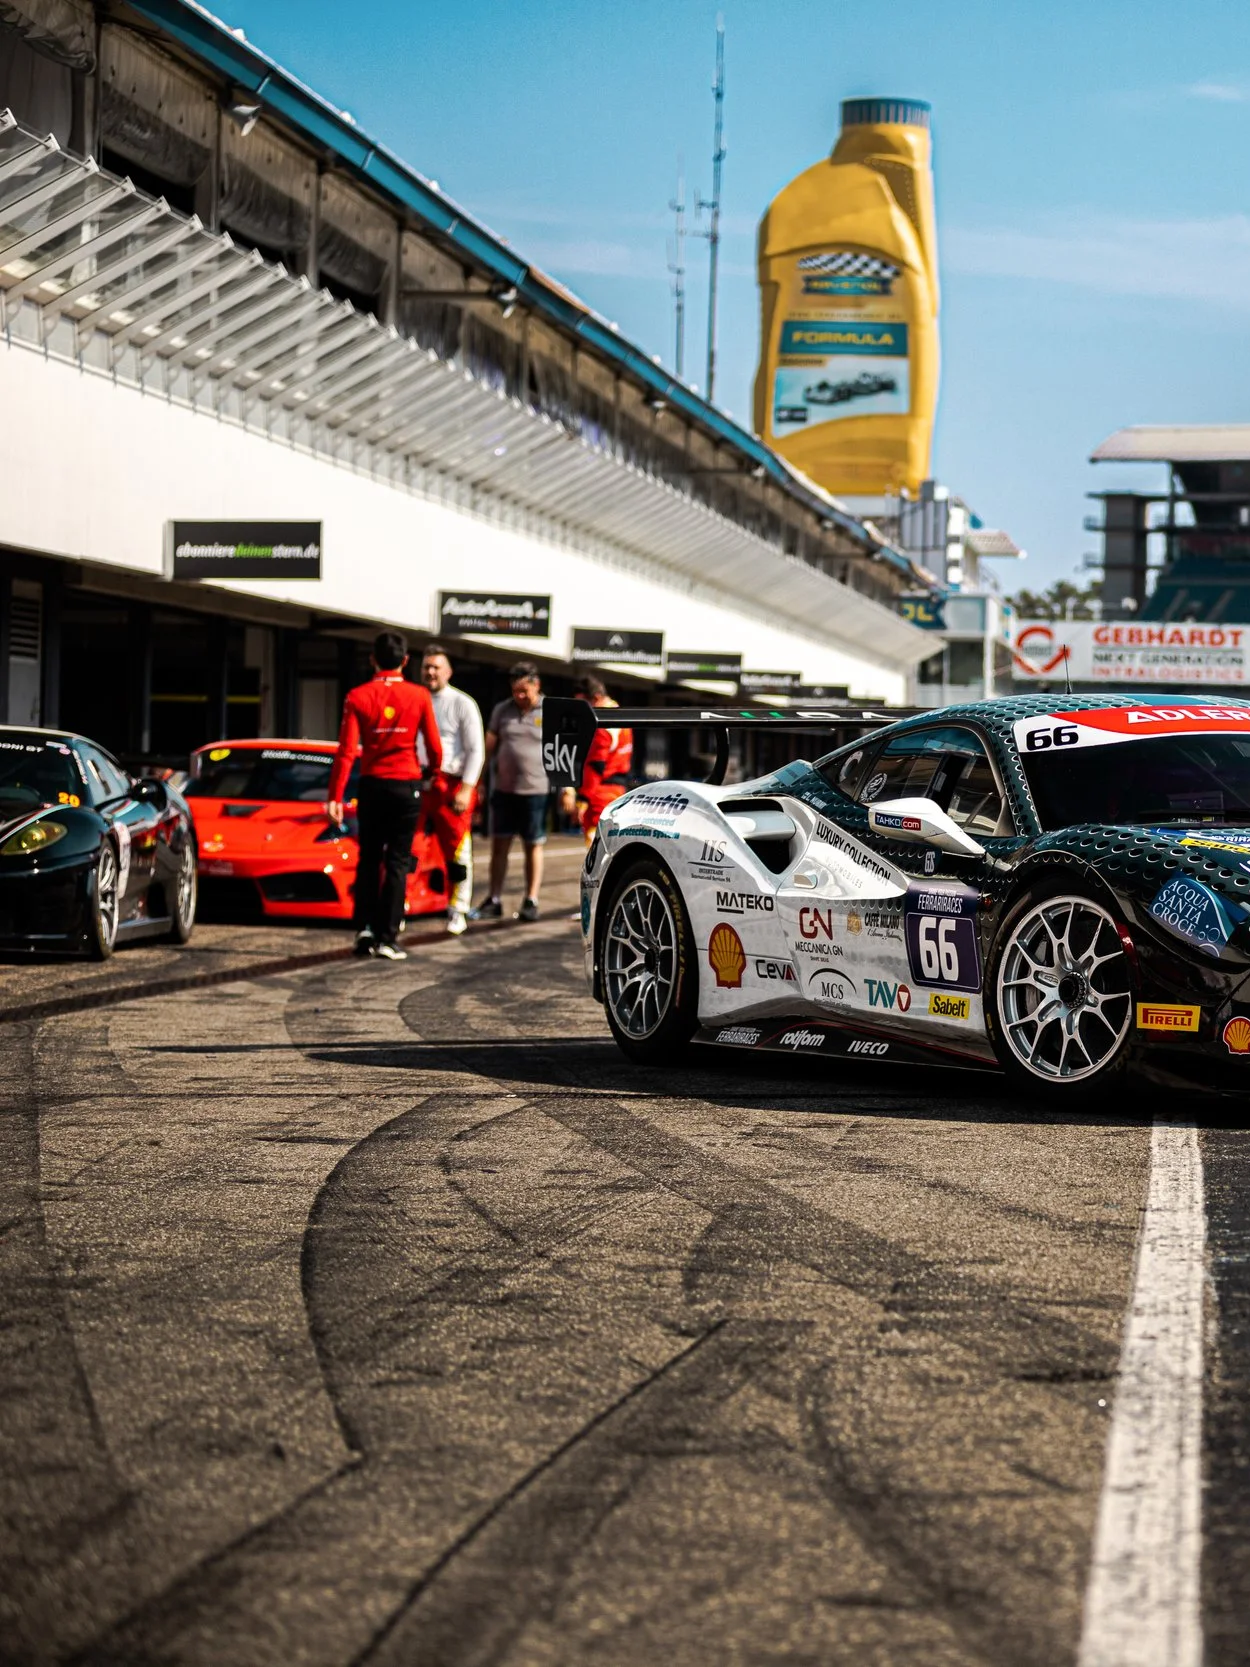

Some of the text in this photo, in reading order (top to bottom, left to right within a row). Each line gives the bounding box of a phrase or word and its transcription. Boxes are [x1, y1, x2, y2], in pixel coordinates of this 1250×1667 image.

[792, 331, 894, 346] FORMULA
[1093, 626, 1244, 647] GEBHARDT
[1093, 652, 1244, 666] NEXT GENERATION
[1092, 666, 1244, 681] INTRALOGISTICS
[1026, 725, 1079, 751] 66
[543, 733, 578, 782] sky
[57, 792, 81, 808] 20
[876, 814, 900, 828] TAHKO
[816, 821, 892, 886] LUXURY COLLECTION
[716, 891, 774, 911] MATEKO
[1168, 880, 1211, 912] ACQUA
[1159, 889, 1202, 925] SANTA
[799, 907, 834, 941] GN
[1152, 902, 1198, 937] CROCE
[794, 940, 844, 957] MECCANICA GN
[918, 916, 959, 982] 66
[820, 981, 844, 1000] MCS
[932, 995, 967, 1018] Sabelt
[1142, 1007, 1194, 1027] PIRELLI
[780, 1029, 826, 1050] rotiform
[848, 1040, 889, 1055] IVECO
